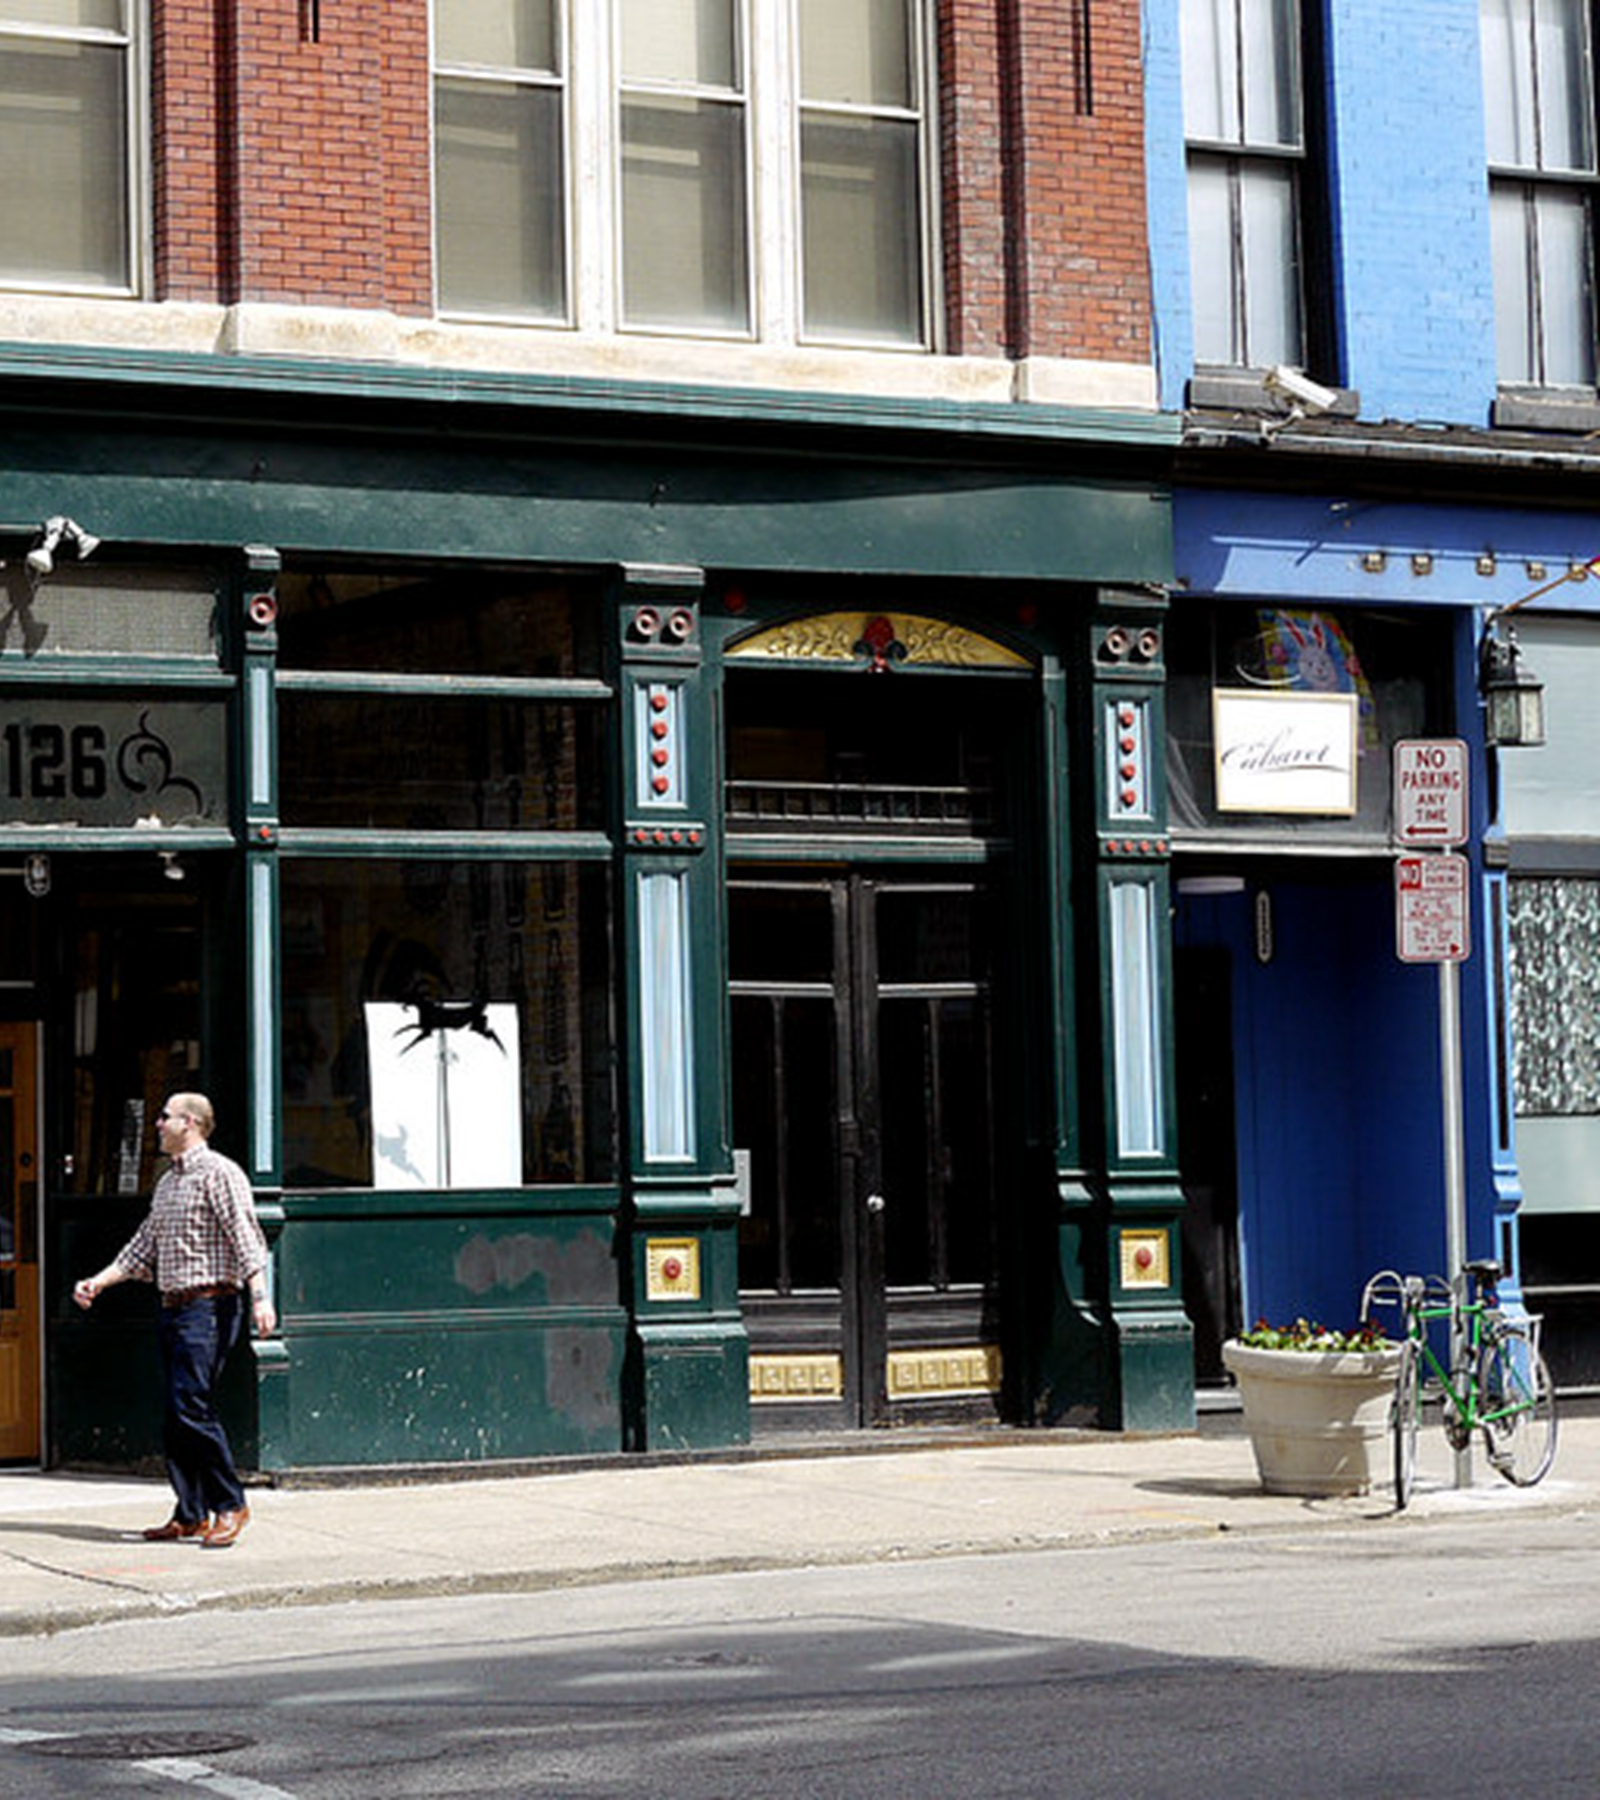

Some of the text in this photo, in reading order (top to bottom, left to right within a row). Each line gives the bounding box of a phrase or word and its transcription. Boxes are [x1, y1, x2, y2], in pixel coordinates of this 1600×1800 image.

[1416, 749, 1446, 769] NO
[1402, 770, 1460, 790] PARKING
[1417, 793, 1448, 806] ANY
[1415, 808, 1447, 823] TIME
